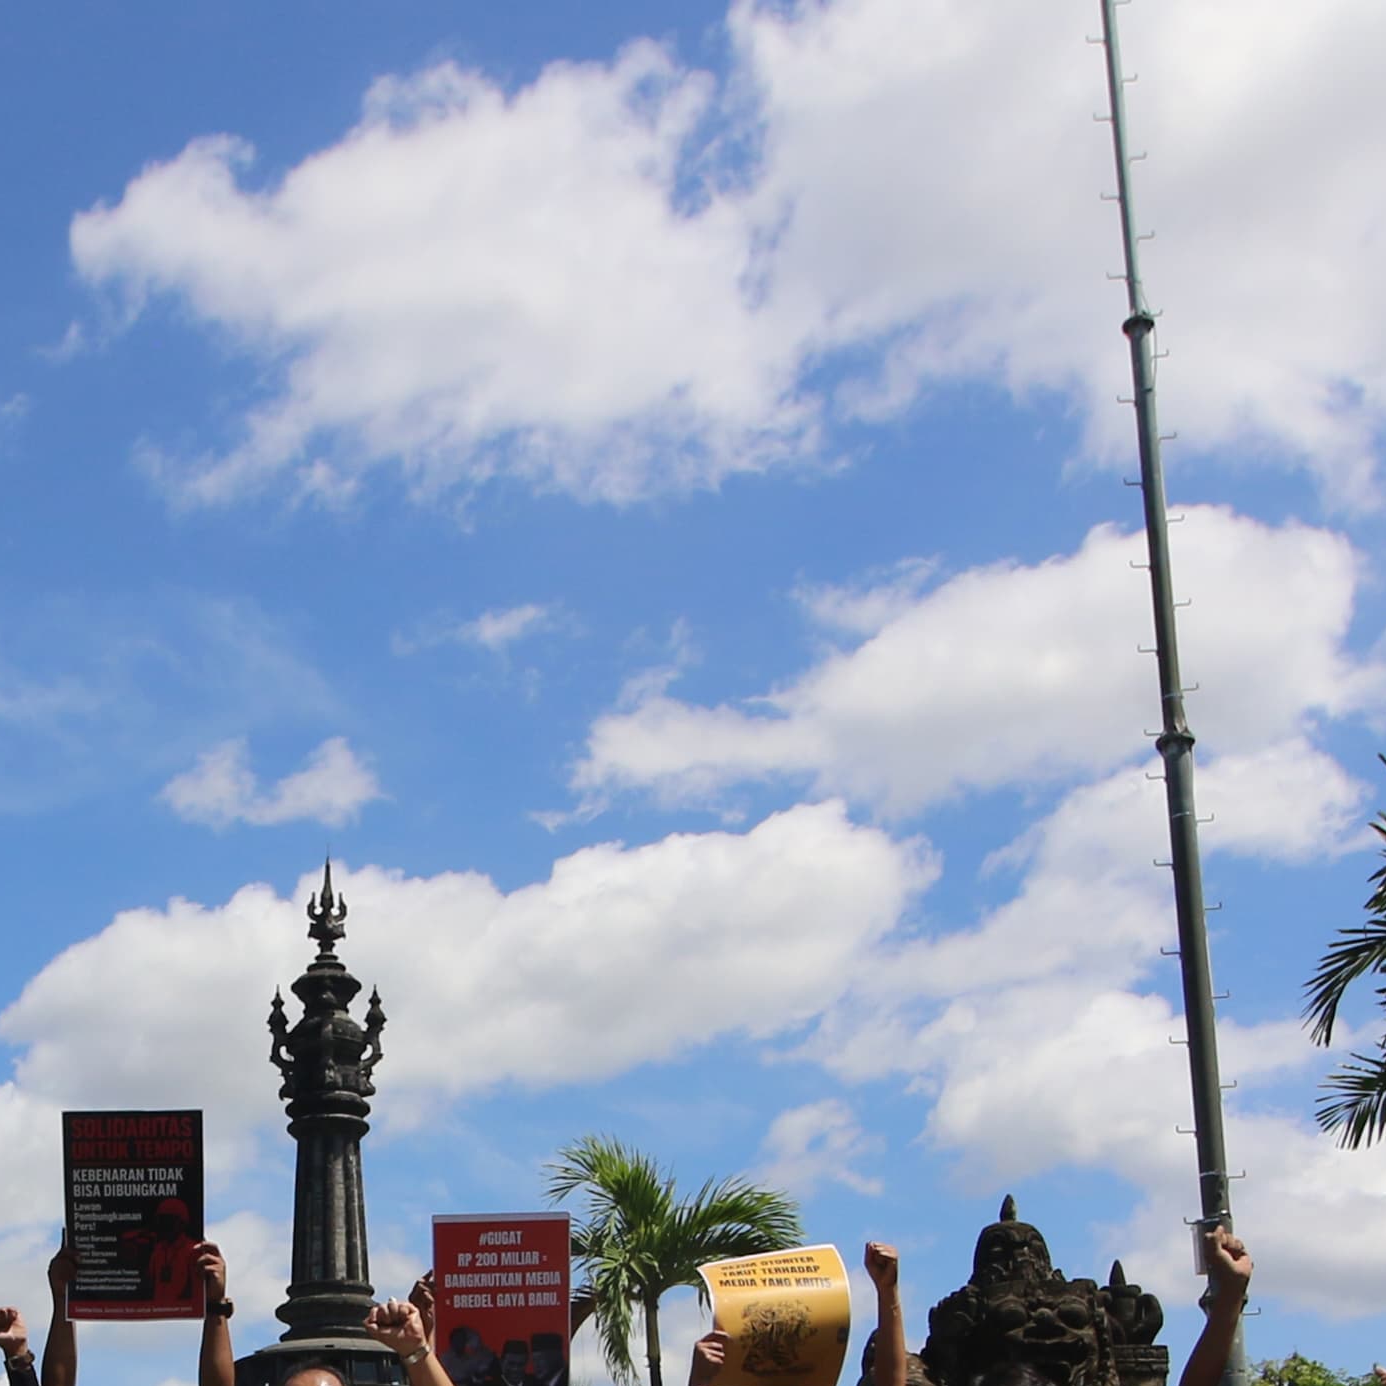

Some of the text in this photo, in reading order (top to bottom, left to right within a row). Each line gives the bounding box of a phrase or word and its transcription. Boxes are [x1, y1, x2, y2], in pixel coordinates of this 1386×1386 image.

[71, 1117, 193, 1138] SOLIDARITAS
[73, 1167, 183, 1182] KEBENARAN TIDAK
[73, 1183, 177, 1197] BISA DIBUNGKAM
